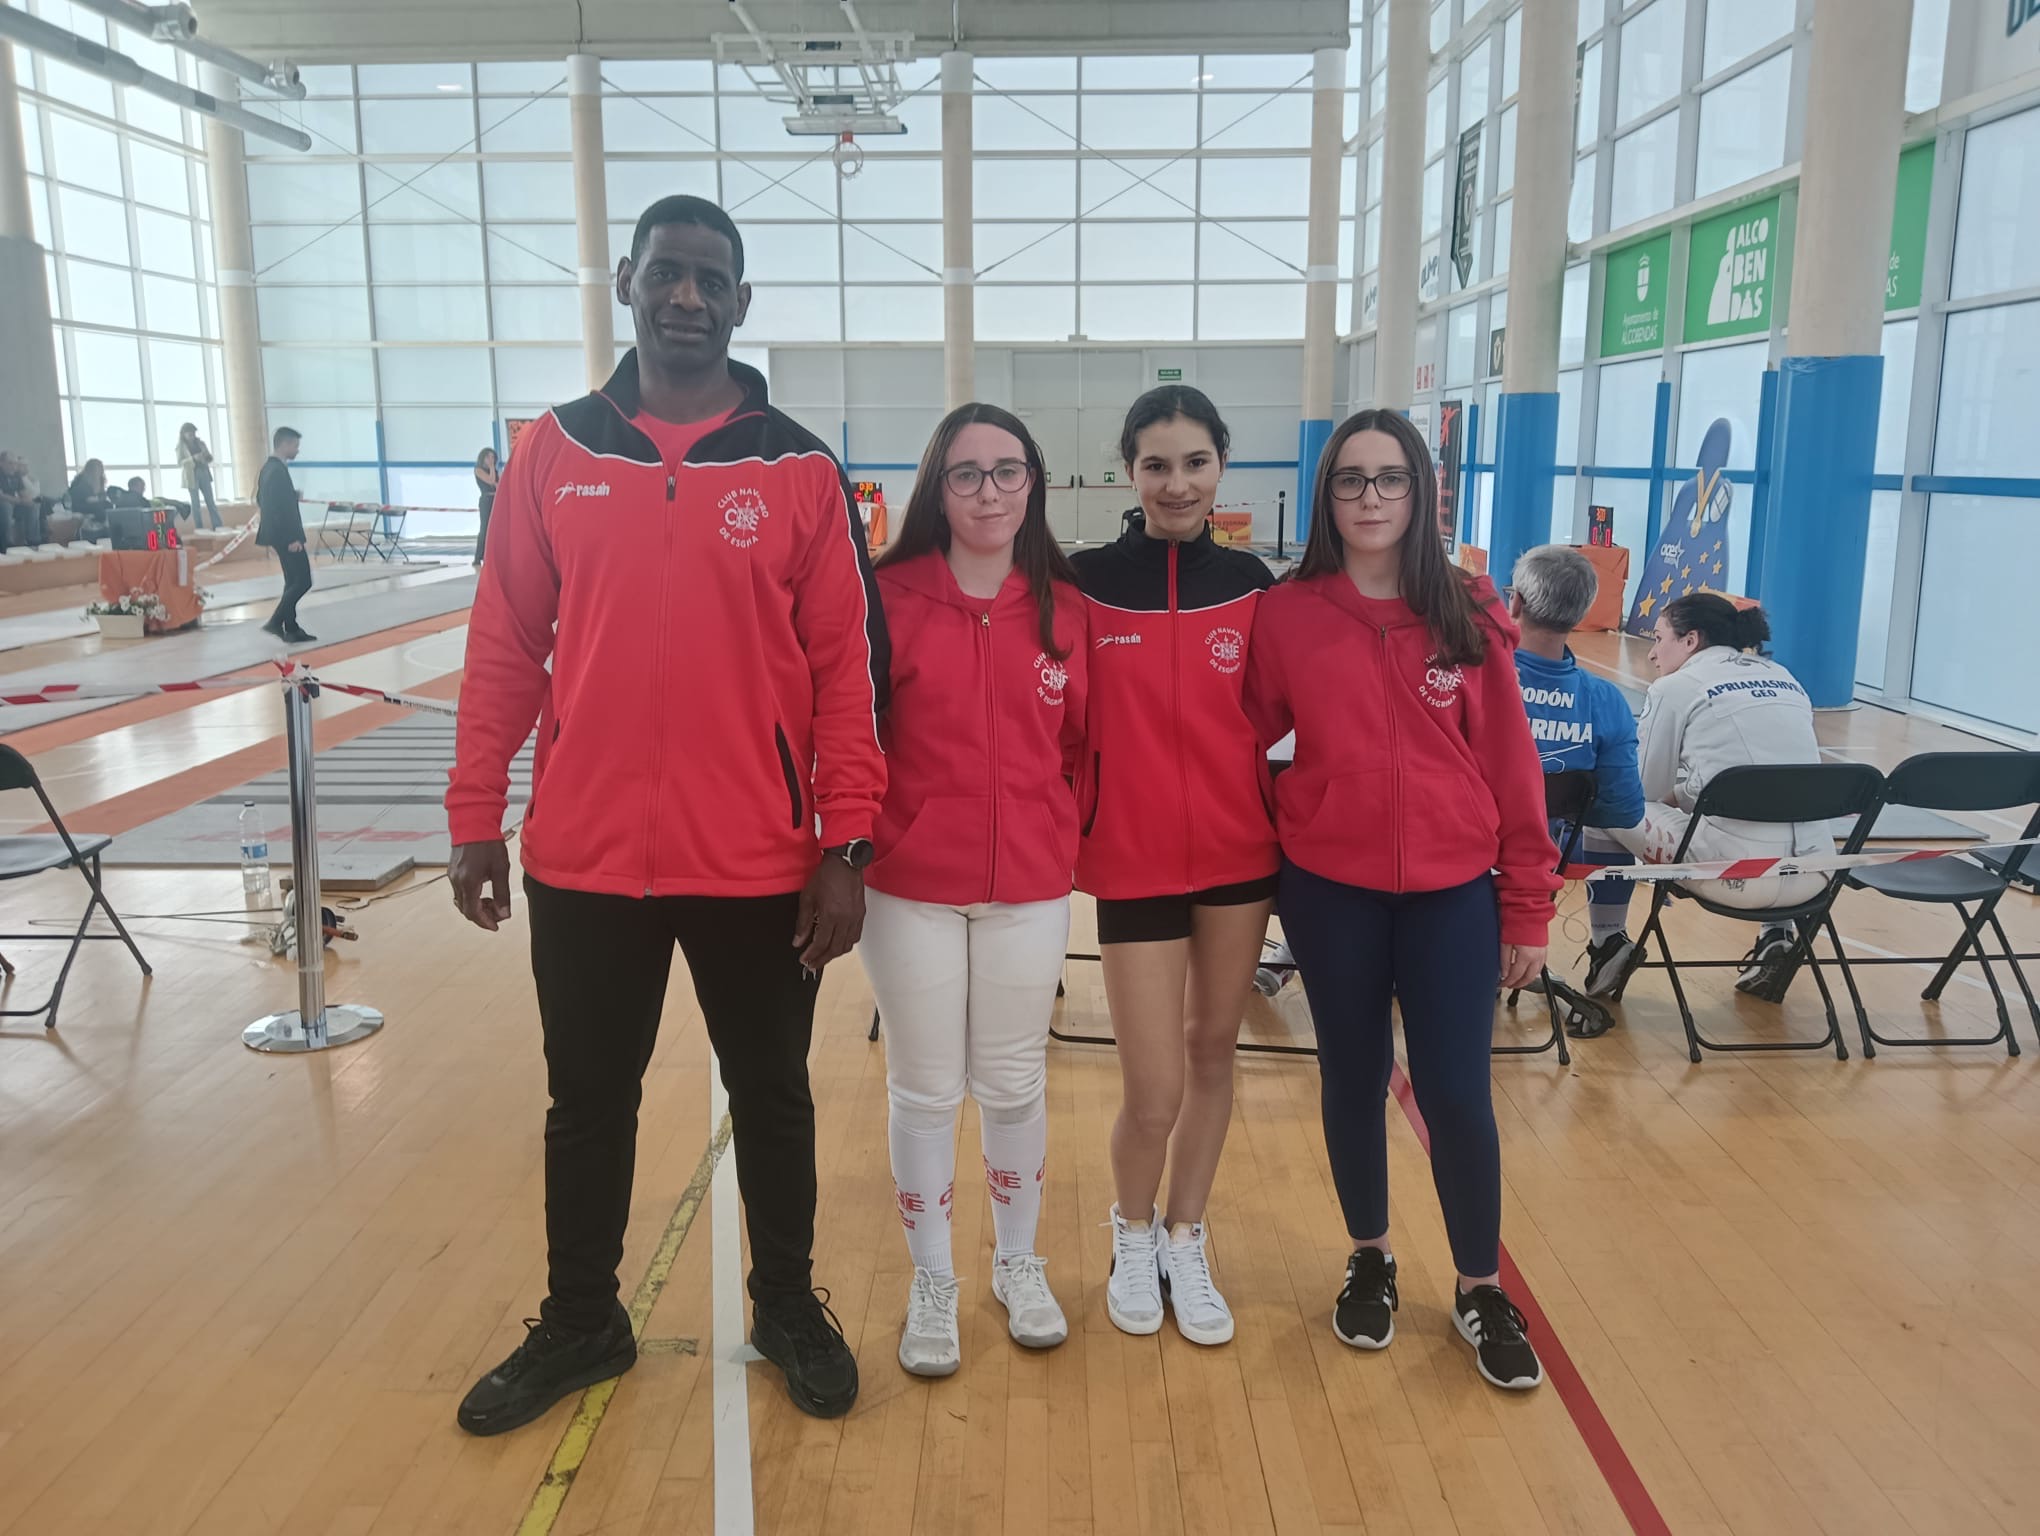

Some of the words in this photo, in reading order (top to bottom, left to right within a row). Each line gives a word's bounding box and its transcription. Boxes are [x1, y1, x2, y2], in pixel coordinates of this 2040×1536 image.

[1736, 217, 1769, 249] ALCO
[1733, 248, 1767, 287] BEN
[1730, 287, 1763, 322] DAS
[1621, 324, 1658, 345] ALCOBENDAS
[717, 490, 738, 509] CLUB
[1204, 630, 1218, 645] CLUB
[1217, 627, 1245, 646] NAVARRO
[1418, 685, 1429, 698] DE
[1426, 695, 1457, 708] ESGRIMA
[1522, 686, 1575, 709] ODÓN
[1750, 689, 1777, 698] GEO
[1527, 717, 1593, 743] RIMA
